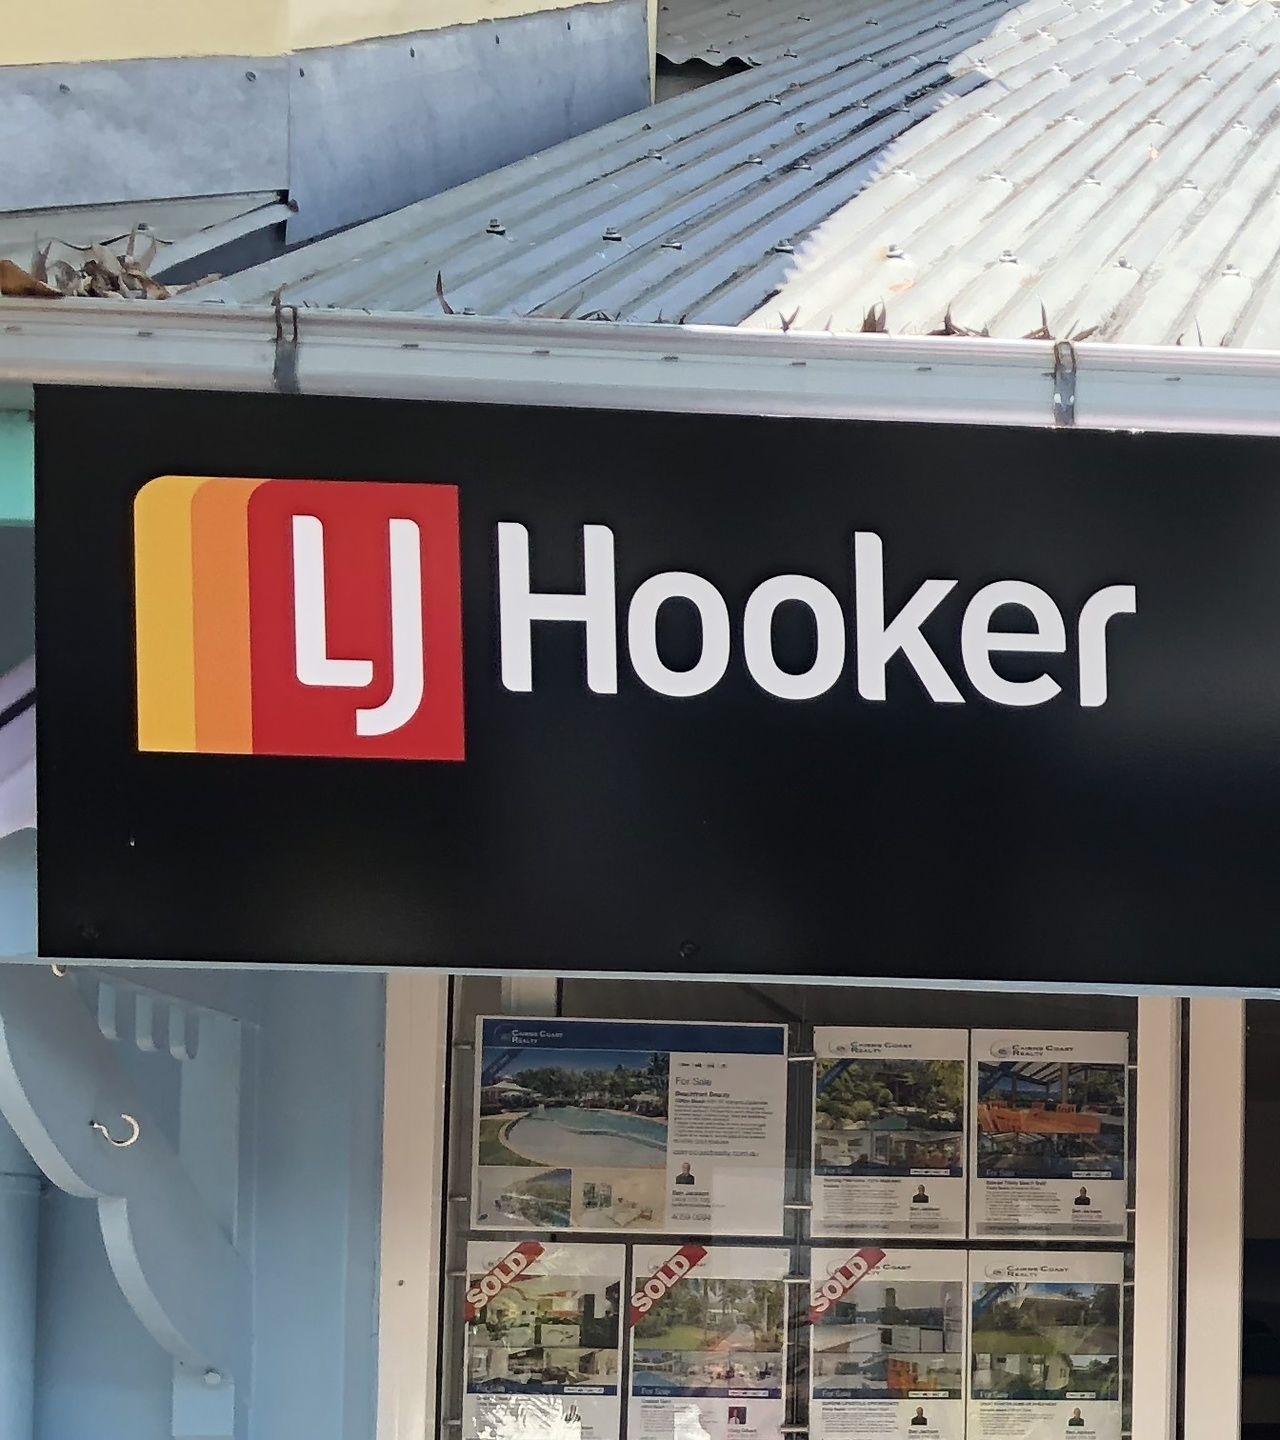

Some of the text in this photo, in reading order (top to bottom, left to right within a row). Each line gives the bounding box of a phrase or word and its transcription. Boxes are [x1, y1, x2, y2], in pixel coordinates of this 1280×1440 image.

[293, 515, 1137, 736] LJ Hooker
[675, 1077, 692, 1086] For
[466, 1251, 528, 1310] SOLD
[631, 1254, 691, 1313] SOLD
[812, 1255, 868, 1313] SOLD
